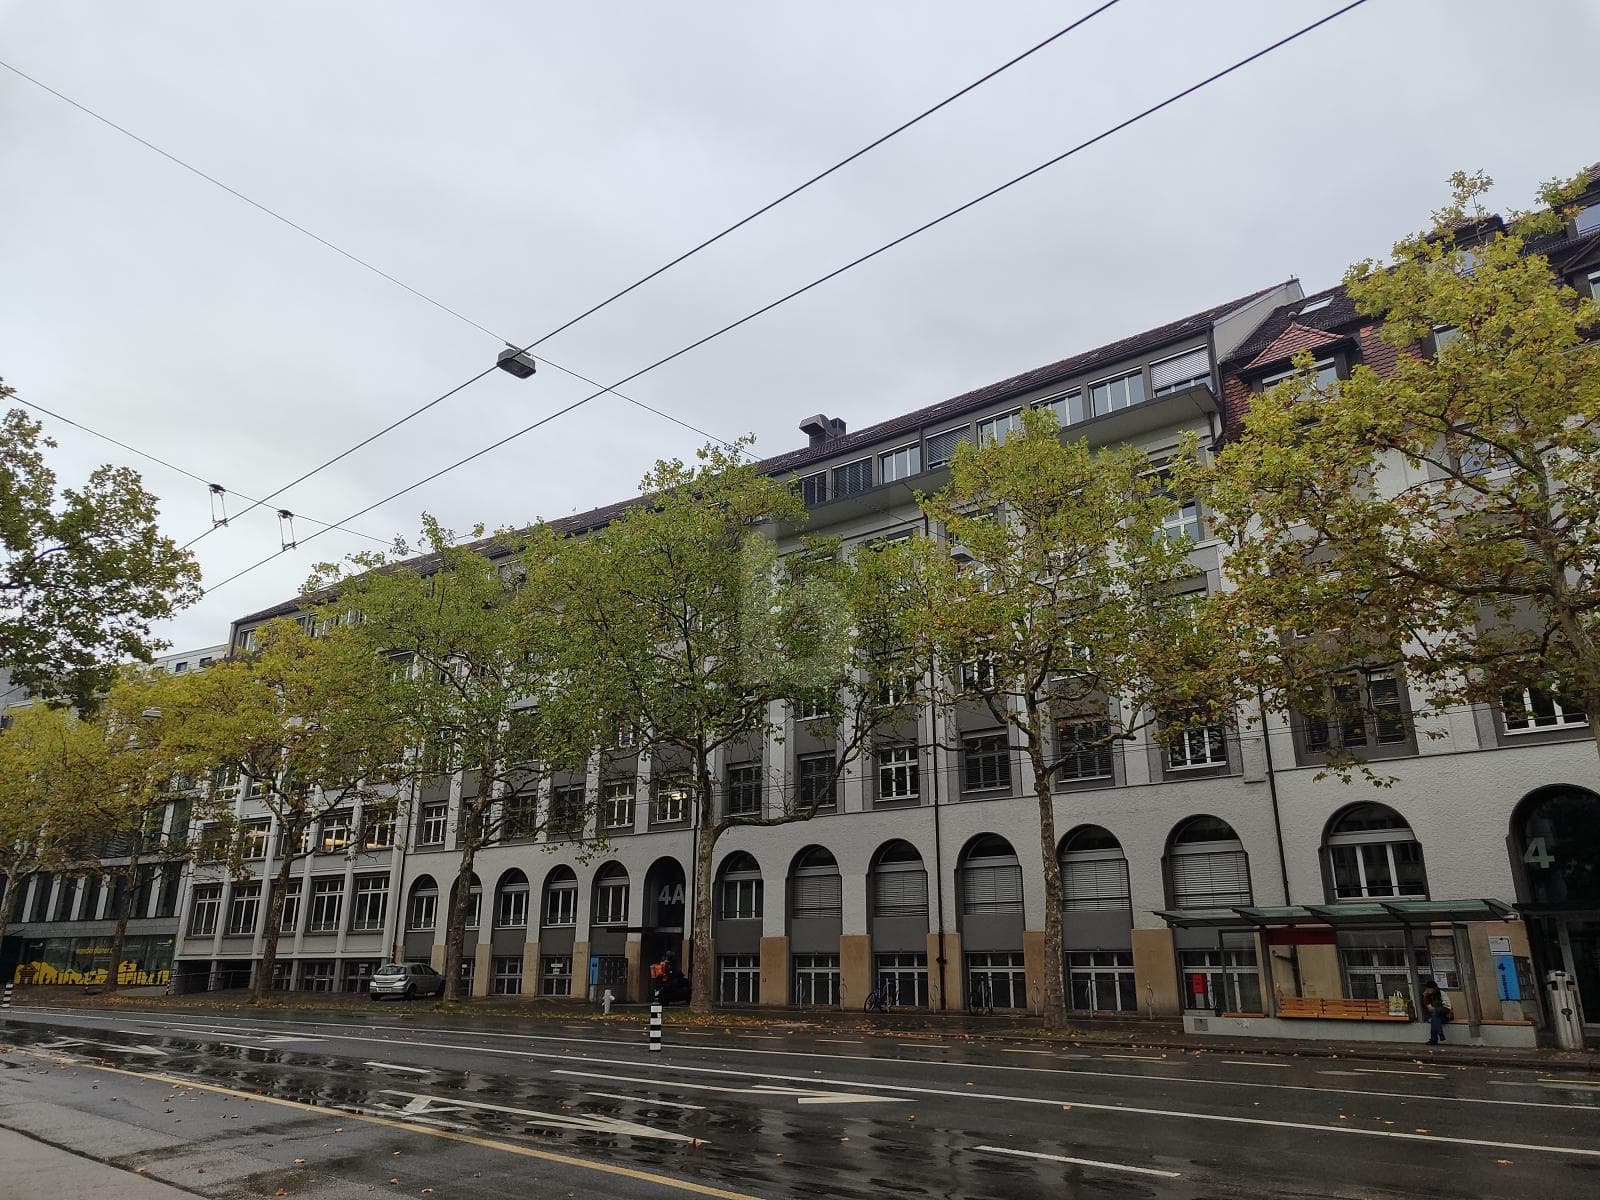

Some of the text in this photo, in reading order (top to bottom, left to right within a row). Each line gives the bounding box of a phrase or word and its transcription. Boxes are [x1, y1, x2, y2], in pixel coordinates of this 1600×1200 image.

[1524, 837, 1555, 869] 4
[658, 883, 685, 905] 4A
[1498, 962, 1506, 972] 4
